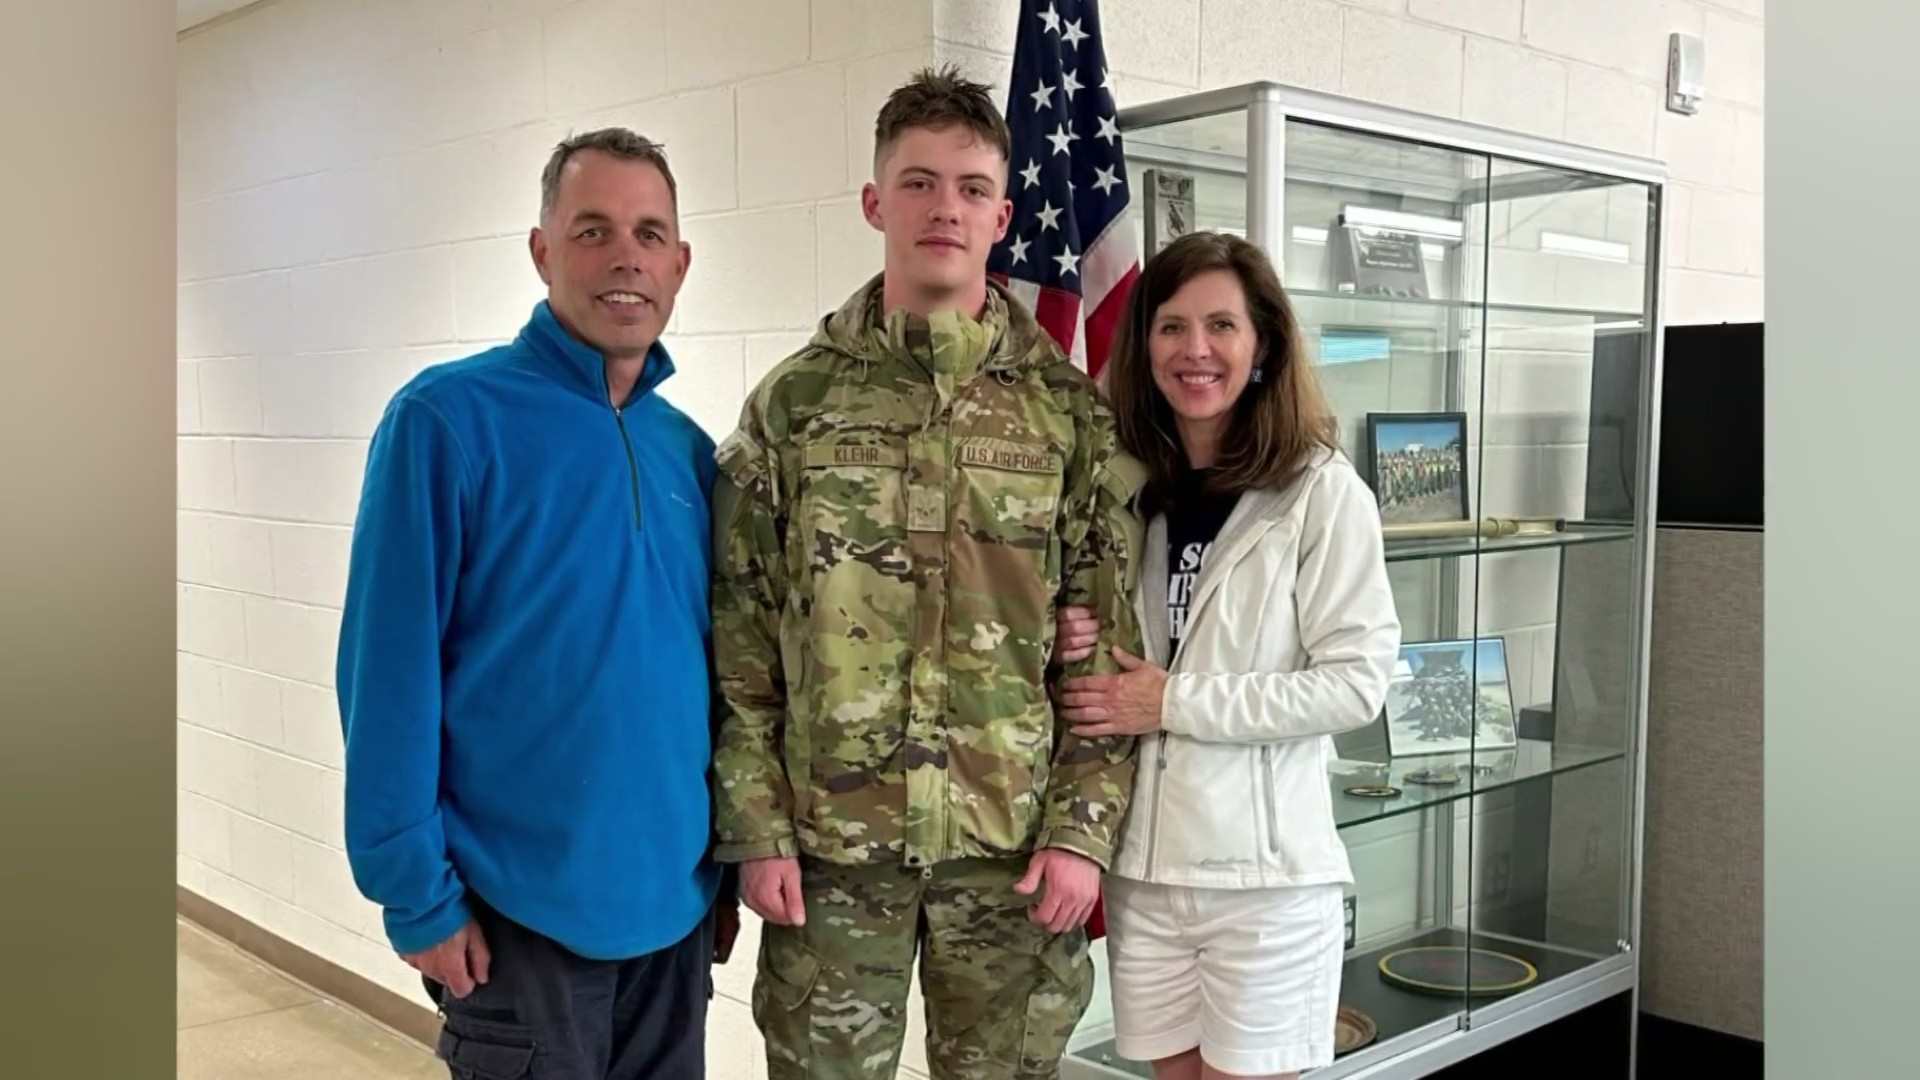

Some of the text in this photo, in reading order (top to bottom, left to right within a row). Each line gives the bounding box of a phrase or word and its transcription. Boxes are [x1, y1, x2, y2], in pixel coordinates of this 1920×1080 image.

[833, 446, 879, 463] KLEHR
[991, 451, 1012, 468] AIR
[1013, 453, 1056, 471] FORCE
